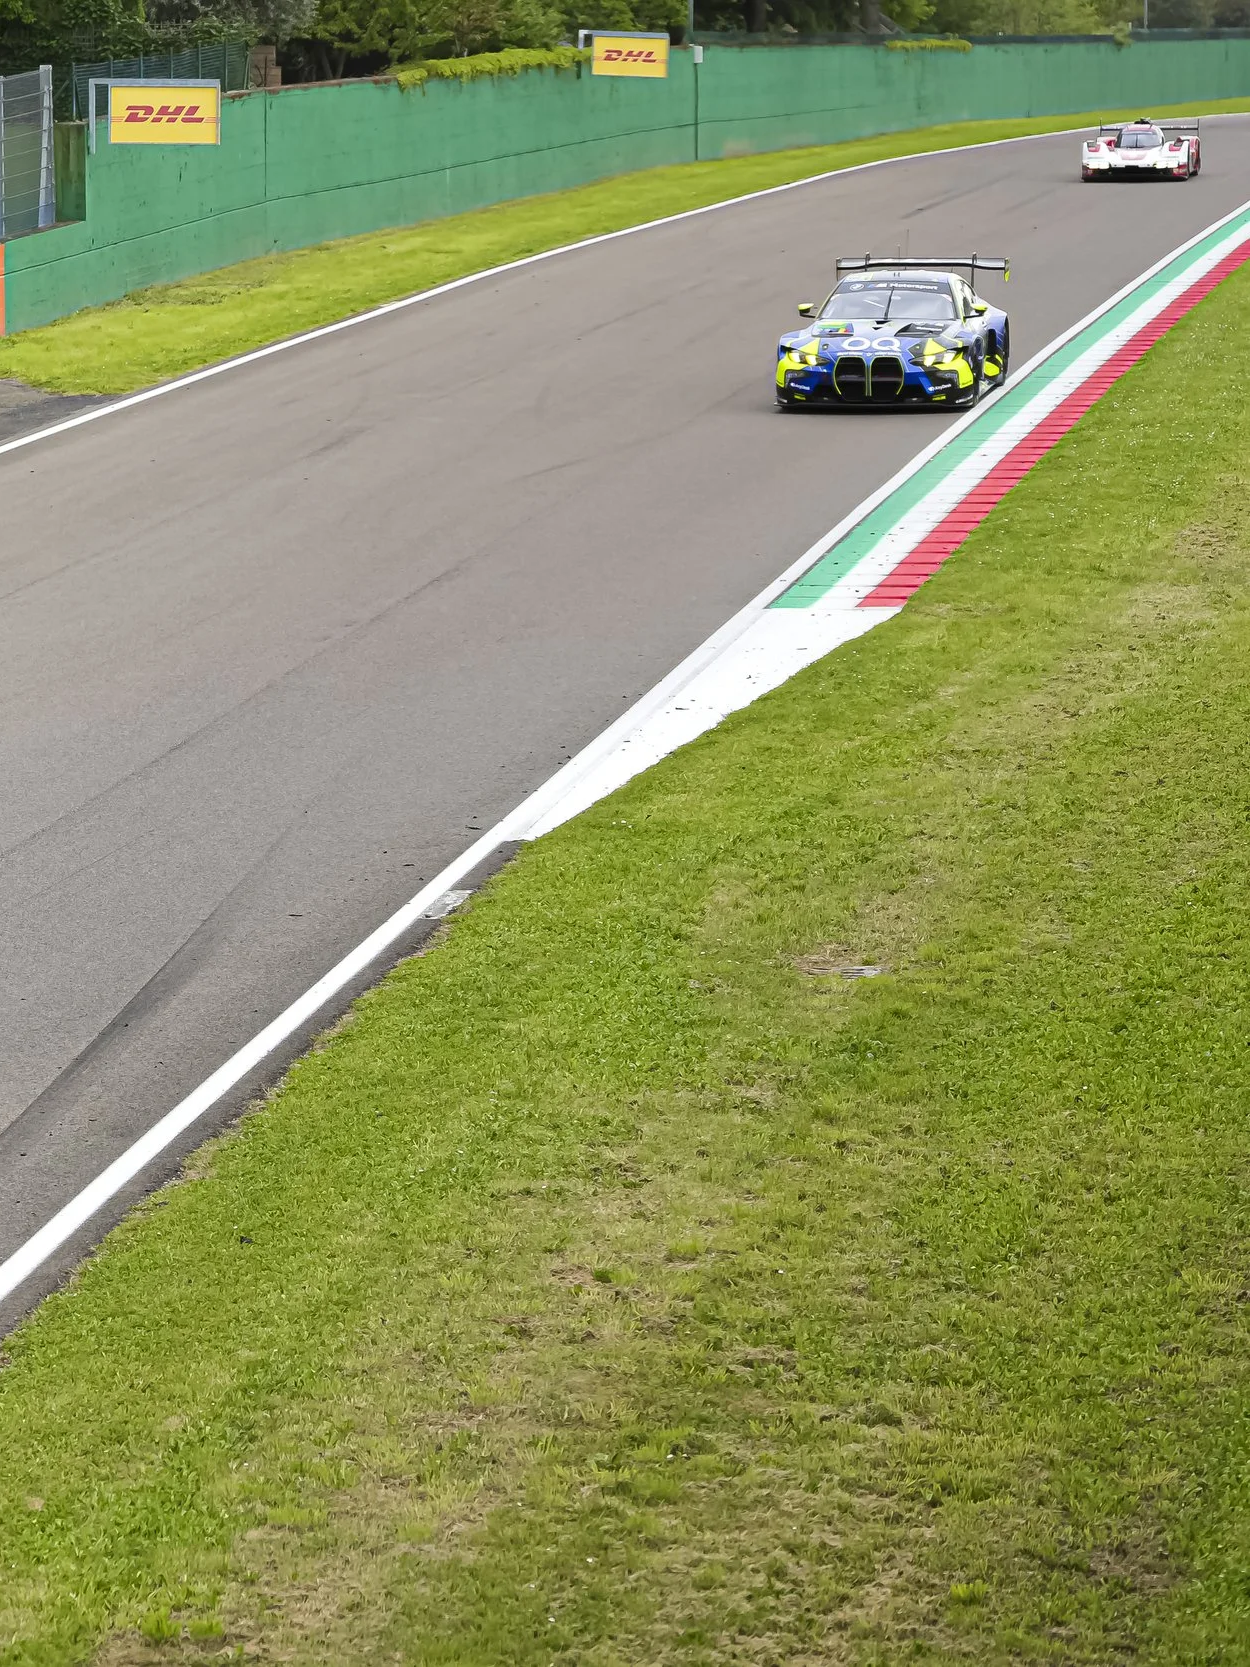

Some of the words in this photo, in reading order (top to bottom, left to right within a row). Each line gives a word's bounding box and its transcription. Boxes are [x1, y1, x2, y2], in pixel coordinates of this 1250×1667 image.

[604, 50, 657, 63] DHL
[124, 105, 205, 123] DHL
[841, 337, 902, 352] OQ
